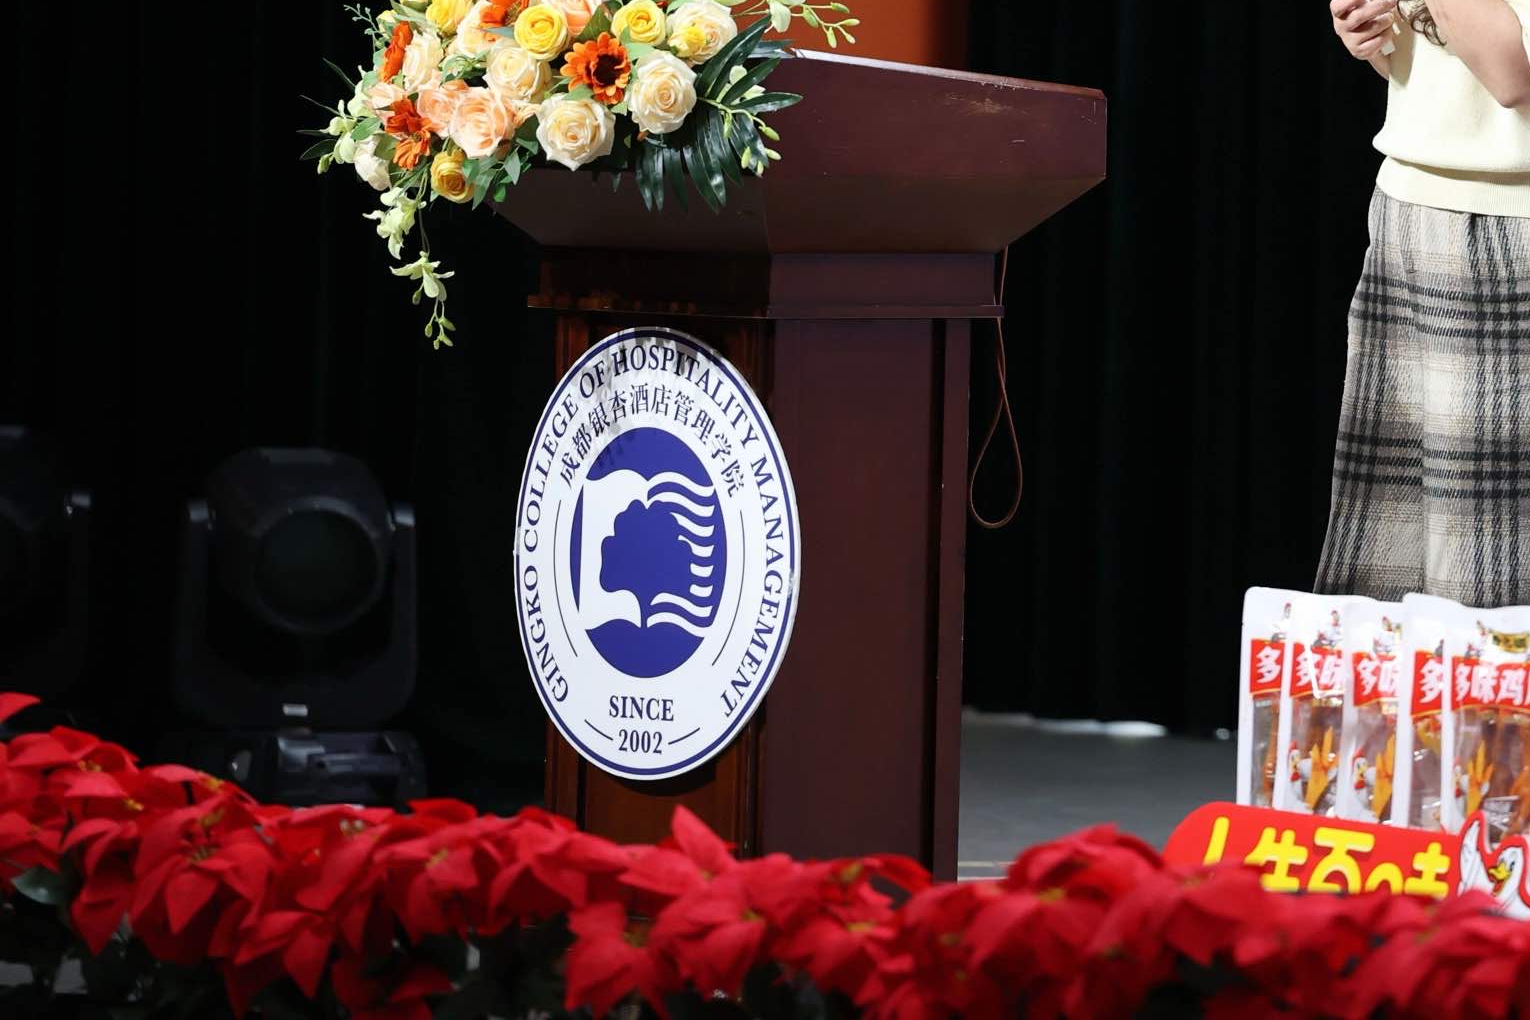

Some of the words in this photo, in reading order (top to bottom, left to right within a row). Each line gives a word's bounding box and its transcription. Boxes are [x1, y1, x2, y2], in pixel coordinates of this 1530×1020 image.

[578, 360, 606, 400] OF
[611, 344, 760, 449] HOSPITALITY
[523, 394, 580, 553] COLLEGE
[560, 382, 745, 498] 成都银杏酒店管理学院
[720, 453, 785, 718] MANAGEMENT
[523, 564, 569, 703] GINGKO
[1256, 646, 1282, 684] 多
[609, 695, 674, 721] SINCE
[1419, 659, 1443, 704] 多
[618, 729, 663, 754] 2002
